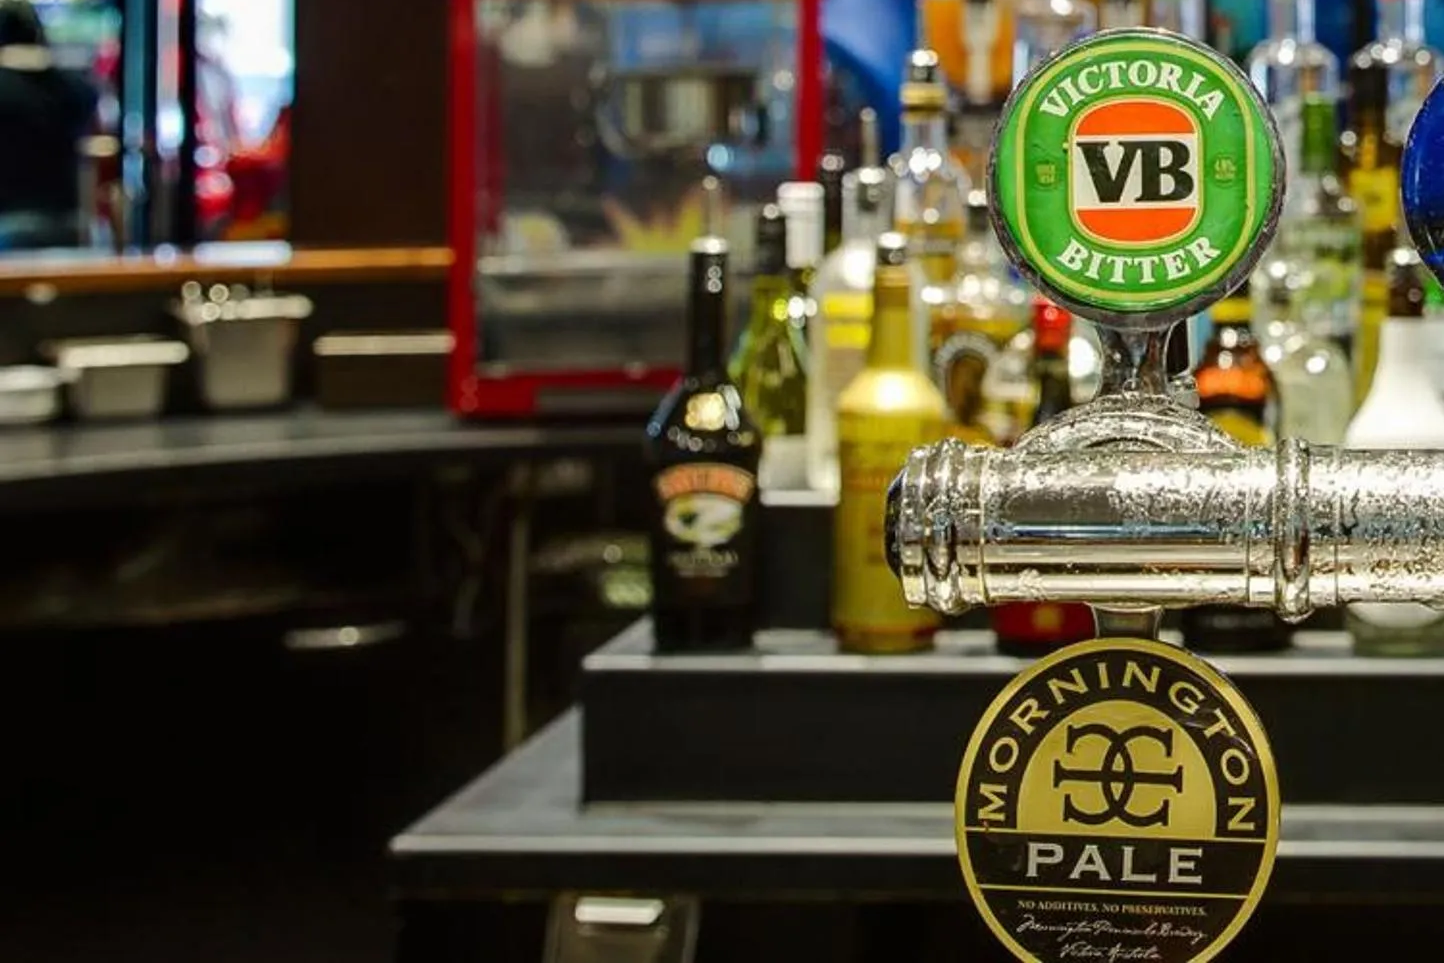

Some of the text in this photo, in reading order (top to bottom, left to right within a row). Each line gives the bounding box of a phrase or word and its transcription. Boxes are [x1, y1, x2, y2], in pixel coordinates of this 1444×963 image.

[1039, 59, 1226, 122] VICTORIA
[1076, 140, 1195, 204] VB
[1056, 236, 1222, 285] BITTER
[977, 661, 1256, 831] MORNINGTON
[1025, 841, 1204, 885] PALE
[1017, 900, 1036, 910] NO
[1102, 903, 1119, 913] NO
